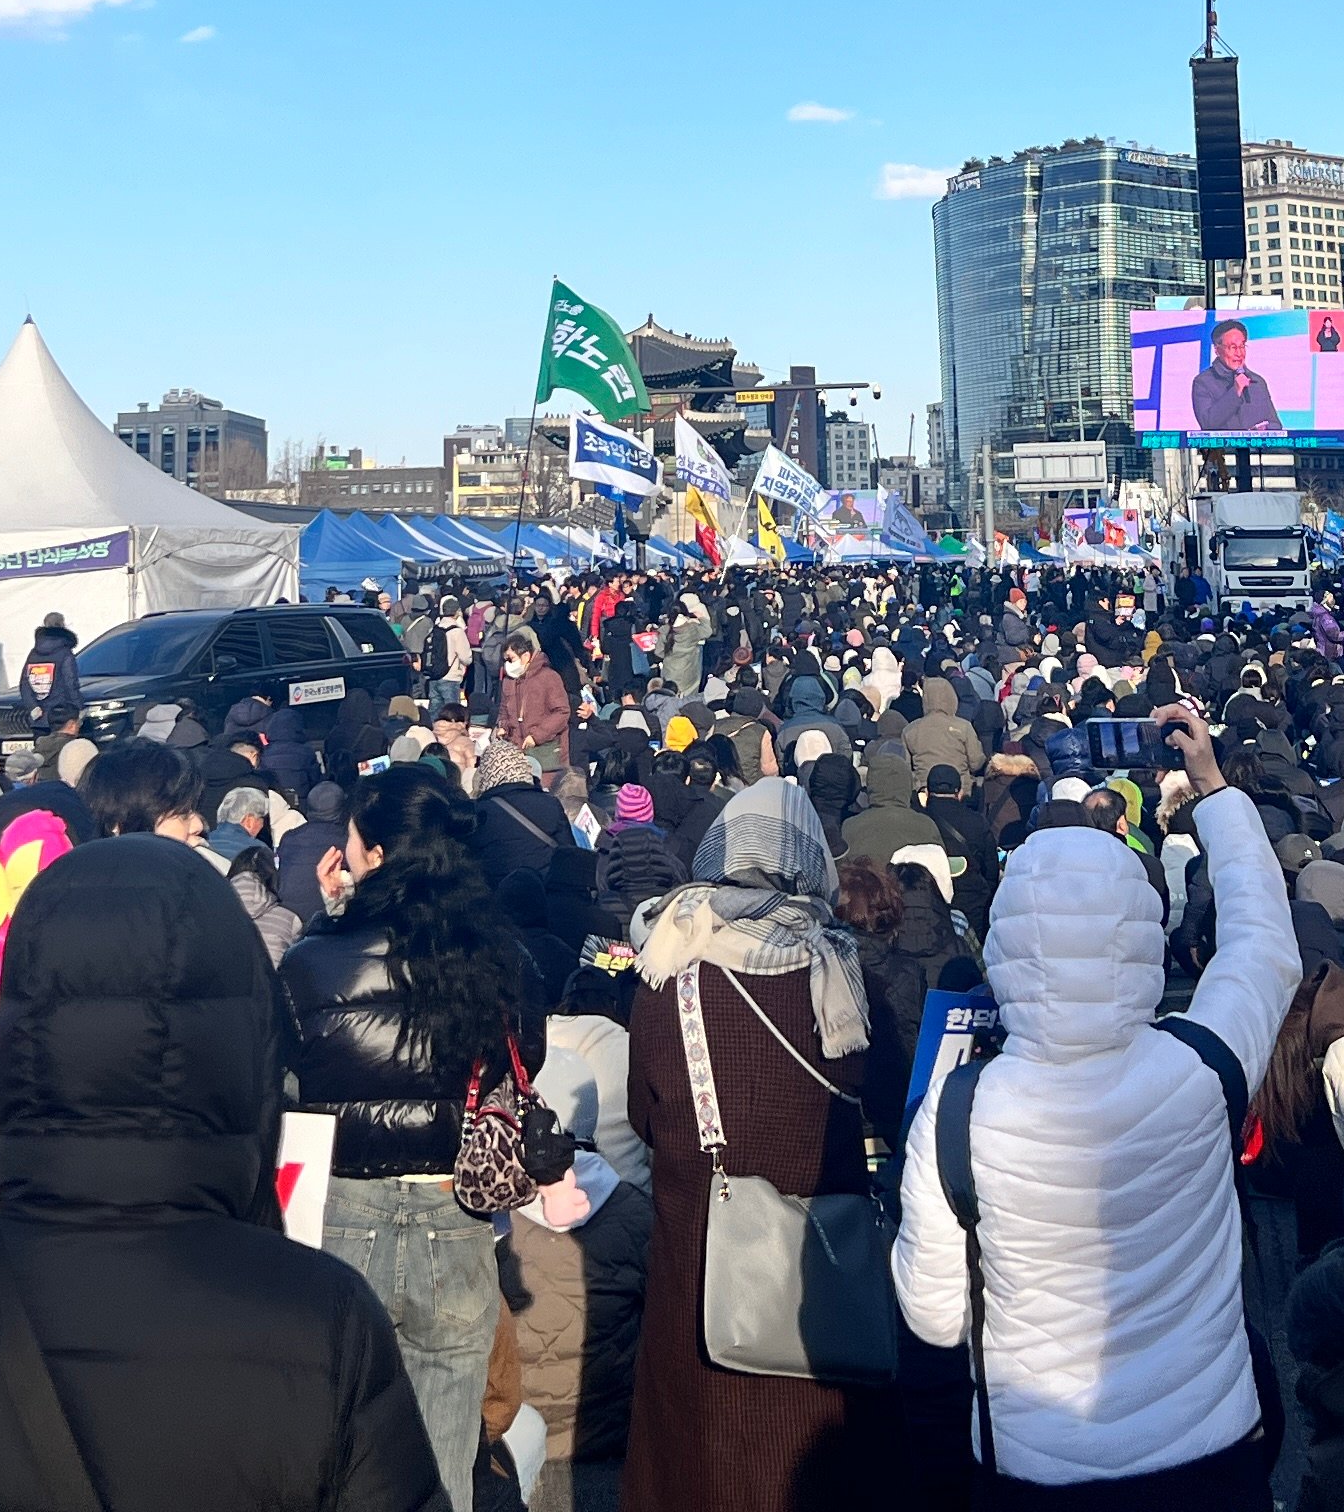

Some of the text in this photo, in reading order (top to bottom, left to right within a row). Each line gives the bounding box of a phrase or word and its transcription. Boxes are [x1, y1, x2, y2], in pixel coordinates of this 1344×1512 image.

[1287, 163, 1344, 185] SOMERSET
[584, 431, 653, 469] 조국혁신당
[945, 1007, 1000, 1031] 한덕
